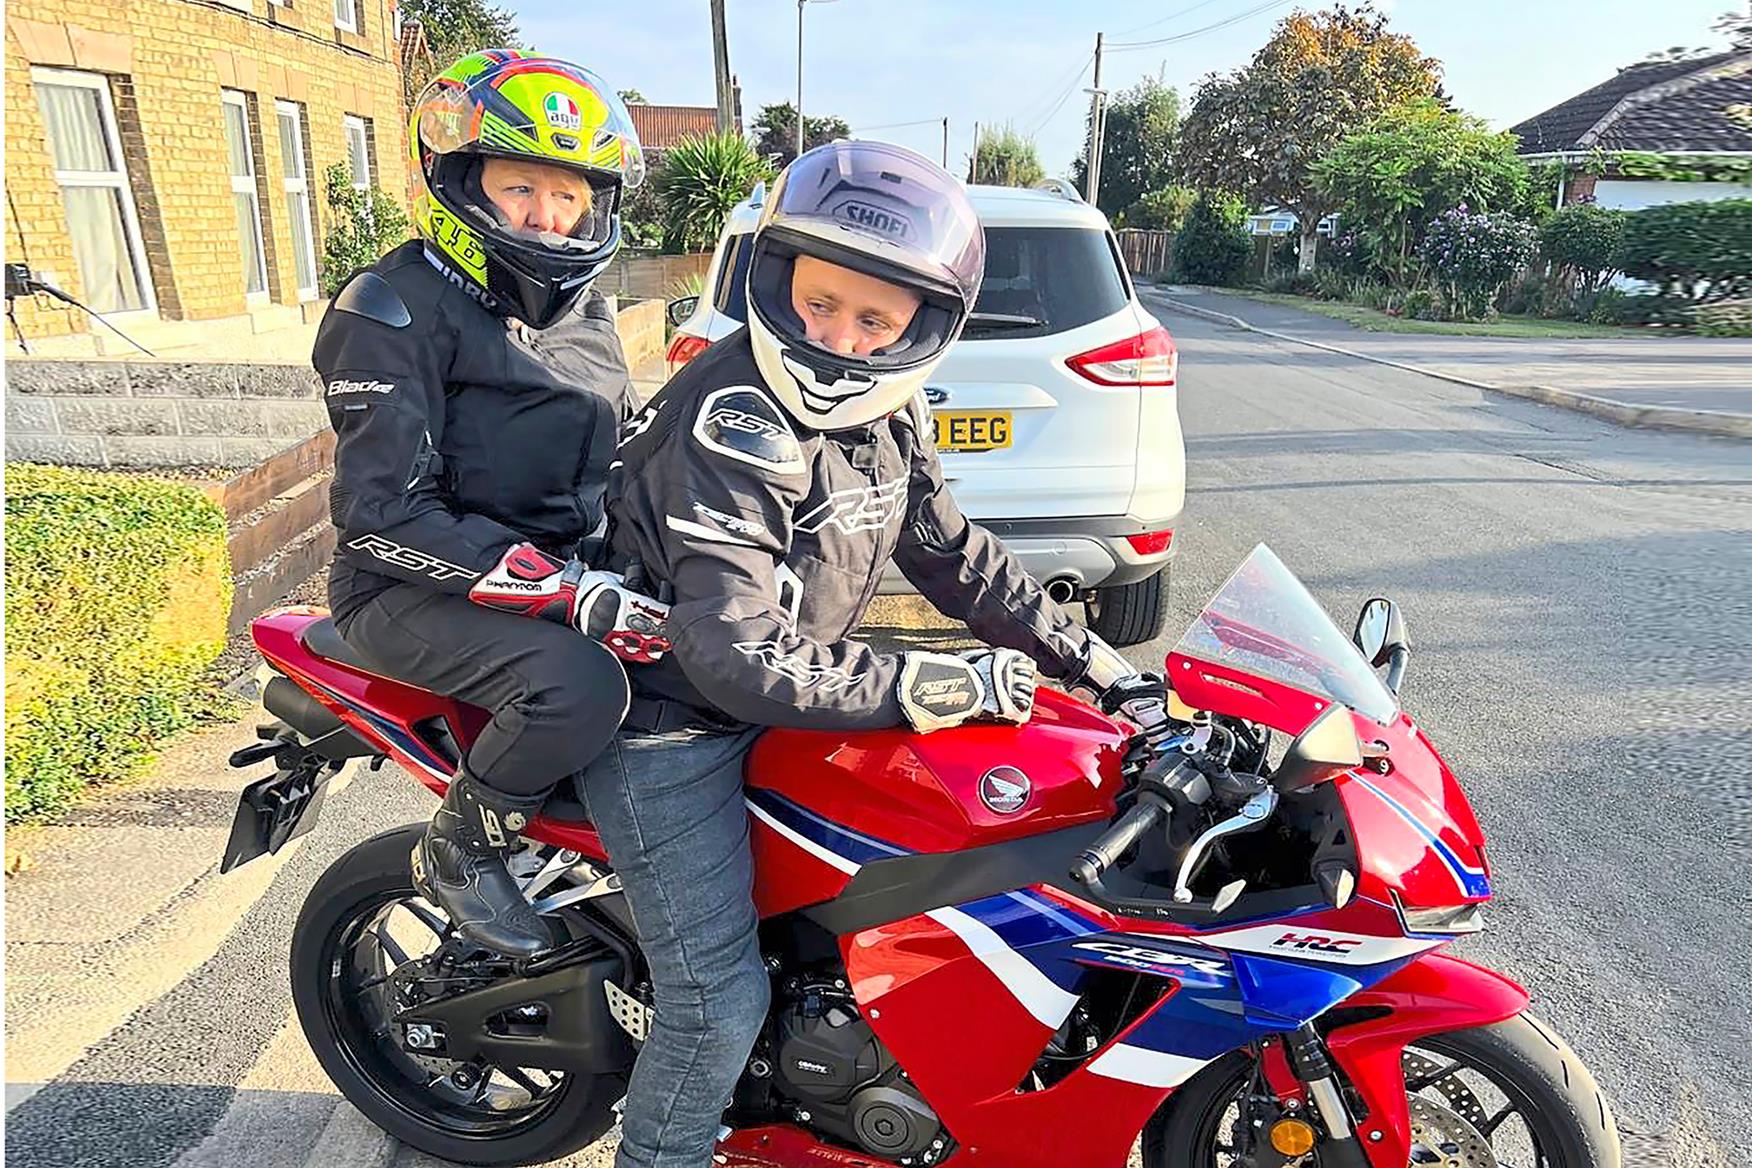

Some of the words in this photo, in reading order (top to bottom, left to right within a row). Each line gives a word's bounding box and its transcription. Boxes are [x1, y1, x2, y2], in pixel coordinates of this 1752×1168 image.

[846, 205, 908, 238] SHOEI
[705, 408, 791, 442] RST
[950, 417, 1007, 444] EEG
[347, 533, 481, 581] RST
[912, 676, 967, 697] RST
[1071, 942, 1234, 977] CBR
[1272, 932, 1363, 954] HRC
